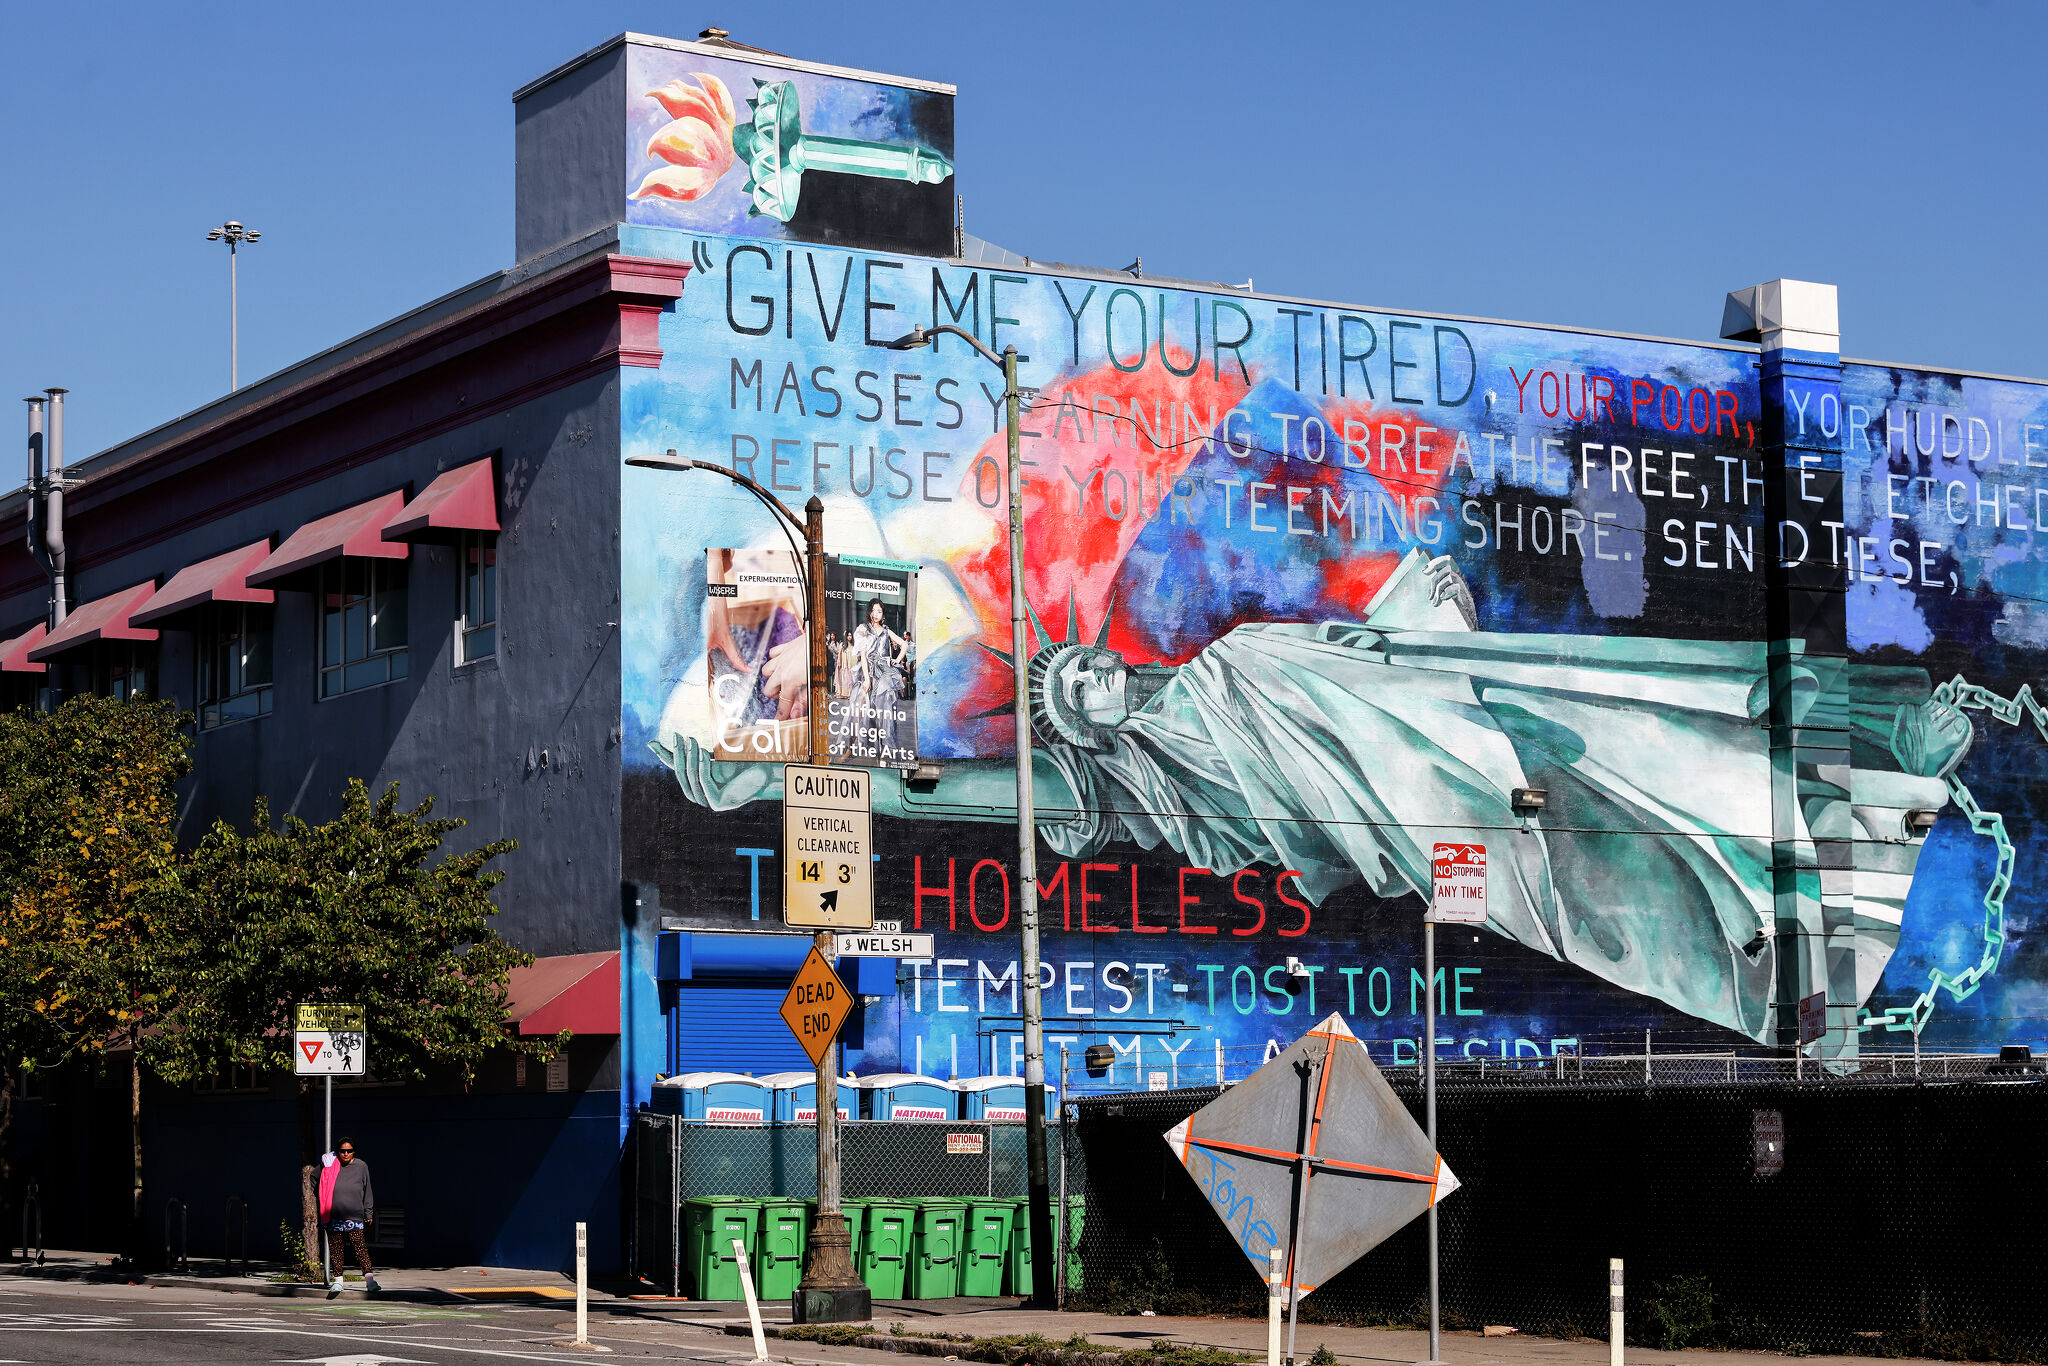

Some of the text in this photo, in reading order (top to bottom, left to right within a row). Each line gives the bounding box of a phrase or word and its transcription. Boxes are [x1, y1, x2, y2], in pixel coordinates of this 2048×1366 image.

[931, 266, 1030, 363] ME
[1053, 280, 1251, 387] YOUR
[1277, 307, 1492, 418] TIRED,
[1509, 366, 1616, 424] YOUR
[1631, 379, 1755, 448] POOR,
[1788, 388, 1872, 452] YOR
[730, 357, 964, 431] MASSES
[1271, 412, 1326, 464] TO
[1343, 419, 1567, 487] BREATHE
[1581, 442, 1709, 510] FREE,
[731, 433, 954, 503] REFUSE
[1064, 465, 1197, 528] YOUR
[1214, 479, 1443, 545] TEEMING
[1462, 499, 1632, 561] SHORE.
[739, 575, 805, 584] EXPERIMENTATION
[856, 581, 899, 592] EXPRESSION
[825, 590, 853, 600] MEETS
[828, 701, 907, 722] California
[828, 720, 887, 743] College
[828, 741, 915, 760] of the Arts
[794, 775, 861, 799] CAUTION
[803, 817, 854, 834] VERTICAL
[797, 837, 860, 855] CLEARANCE
[1435, 864, 1485, 878] NO STOPPING
[913, 855, 1311, 938] HOMELESS
[1437, 885, 1484, 899] ANY TIME
[857, 938, 913, 952] WELSH
[797, 981, 835, 1006] DEAD
[1338, 967, 1392, 1017] TO
[1410, 967, 1484, 1017] ME
[301, 1009, 341, 1018] TURNING
[300, 1020, 342, 1029] VEHICLES
[803, 1012, 831, 1036] END
[323, 1051, 333, 1059] TO
[709, 1110, 761, 1121] NATIONAL
[894, 1110, 945, 1120] NATIONAL
[947, 1134, 983, 1144] NATIONAL
